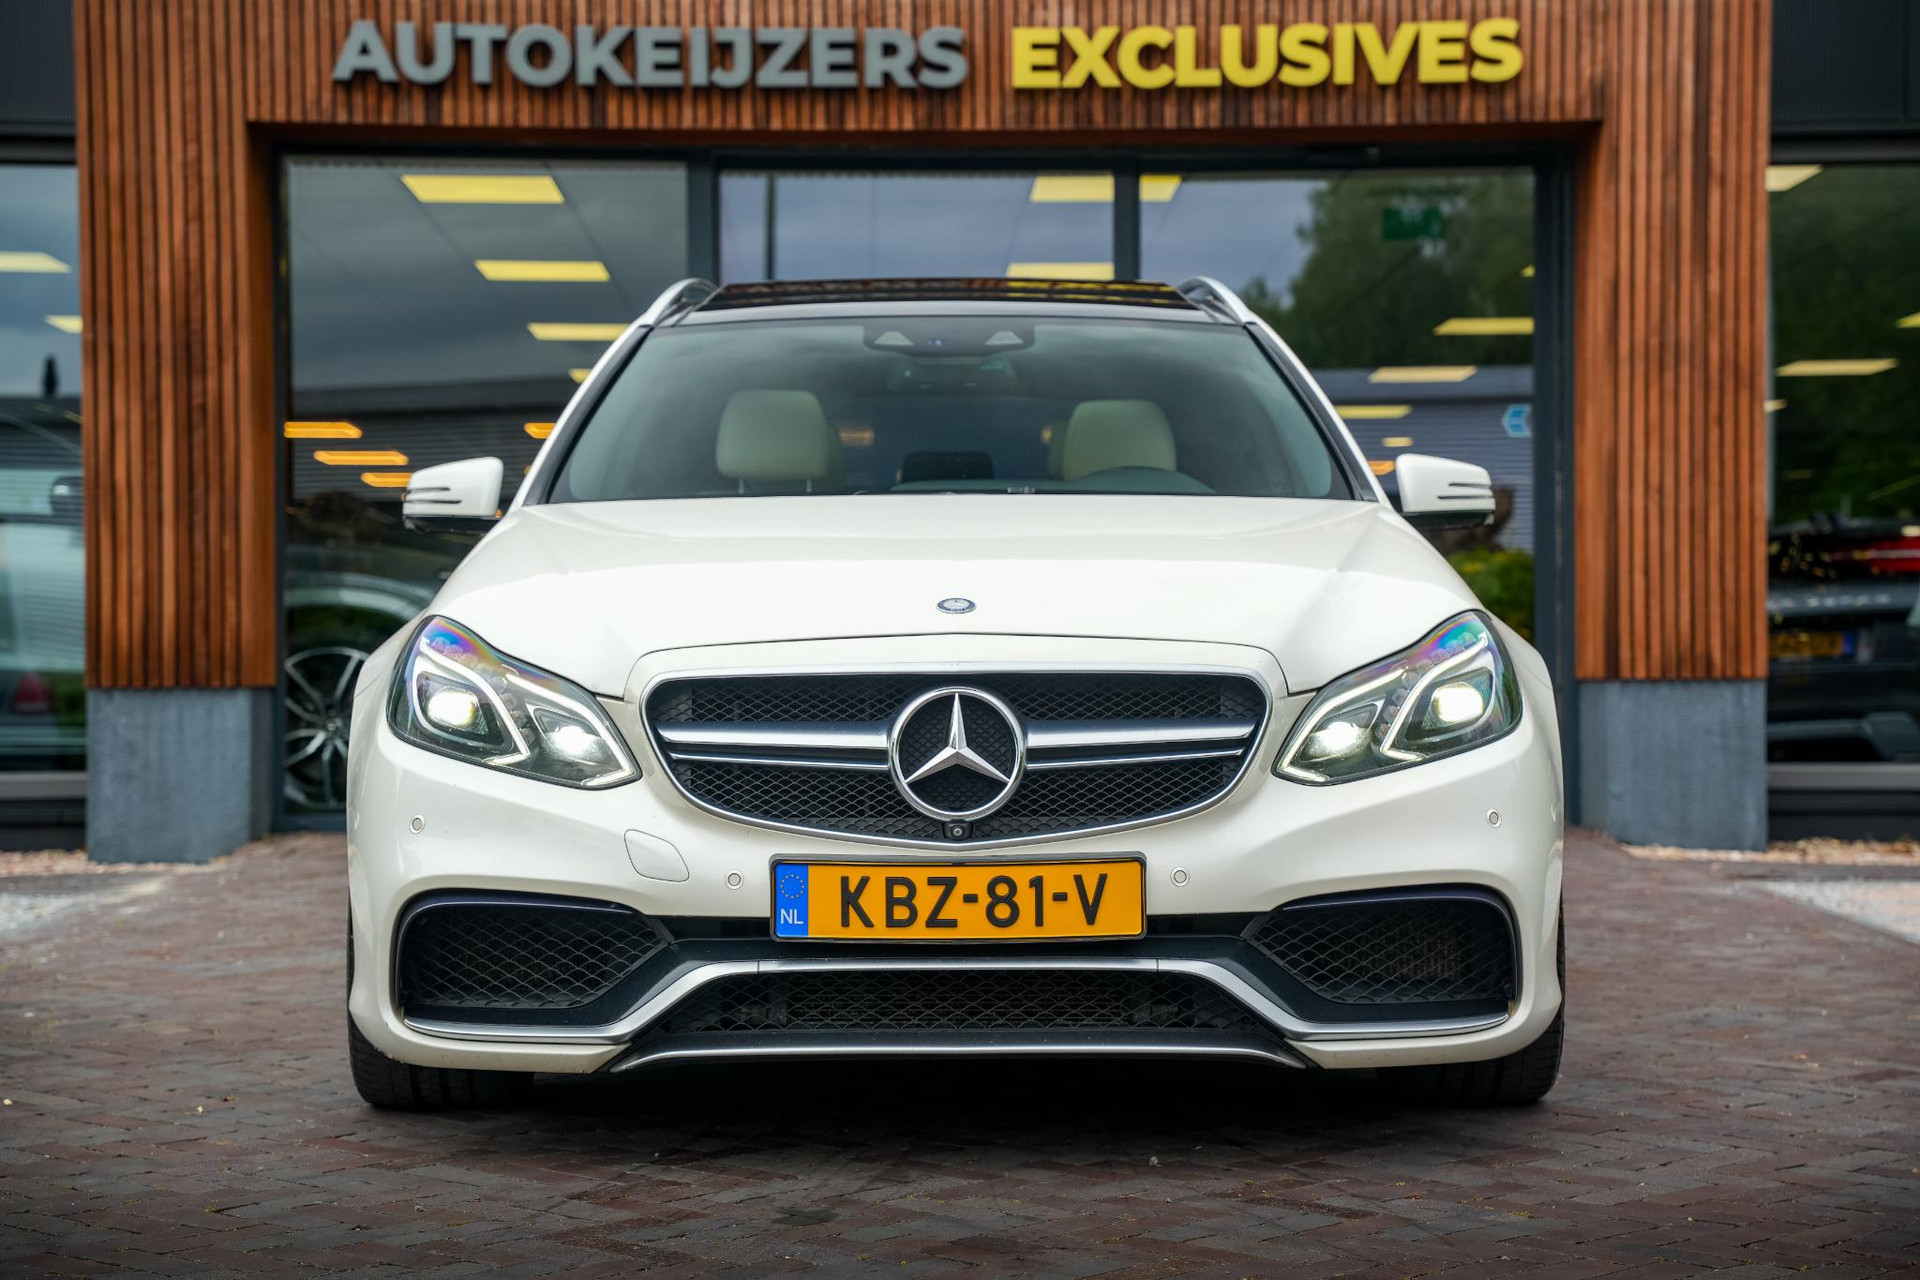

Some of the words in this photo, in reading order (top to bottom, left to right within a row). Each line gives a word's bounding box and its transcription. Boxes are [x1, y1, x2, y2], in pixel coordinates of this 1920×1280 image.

[332, 19, 969, 90] AUTOKEIJZERS
[1011, 17, 1525, 90] EXCLUSIVES
[779, 908, 804, 925] NL
[840, 873, 1108, 929] KBZ-81-V
